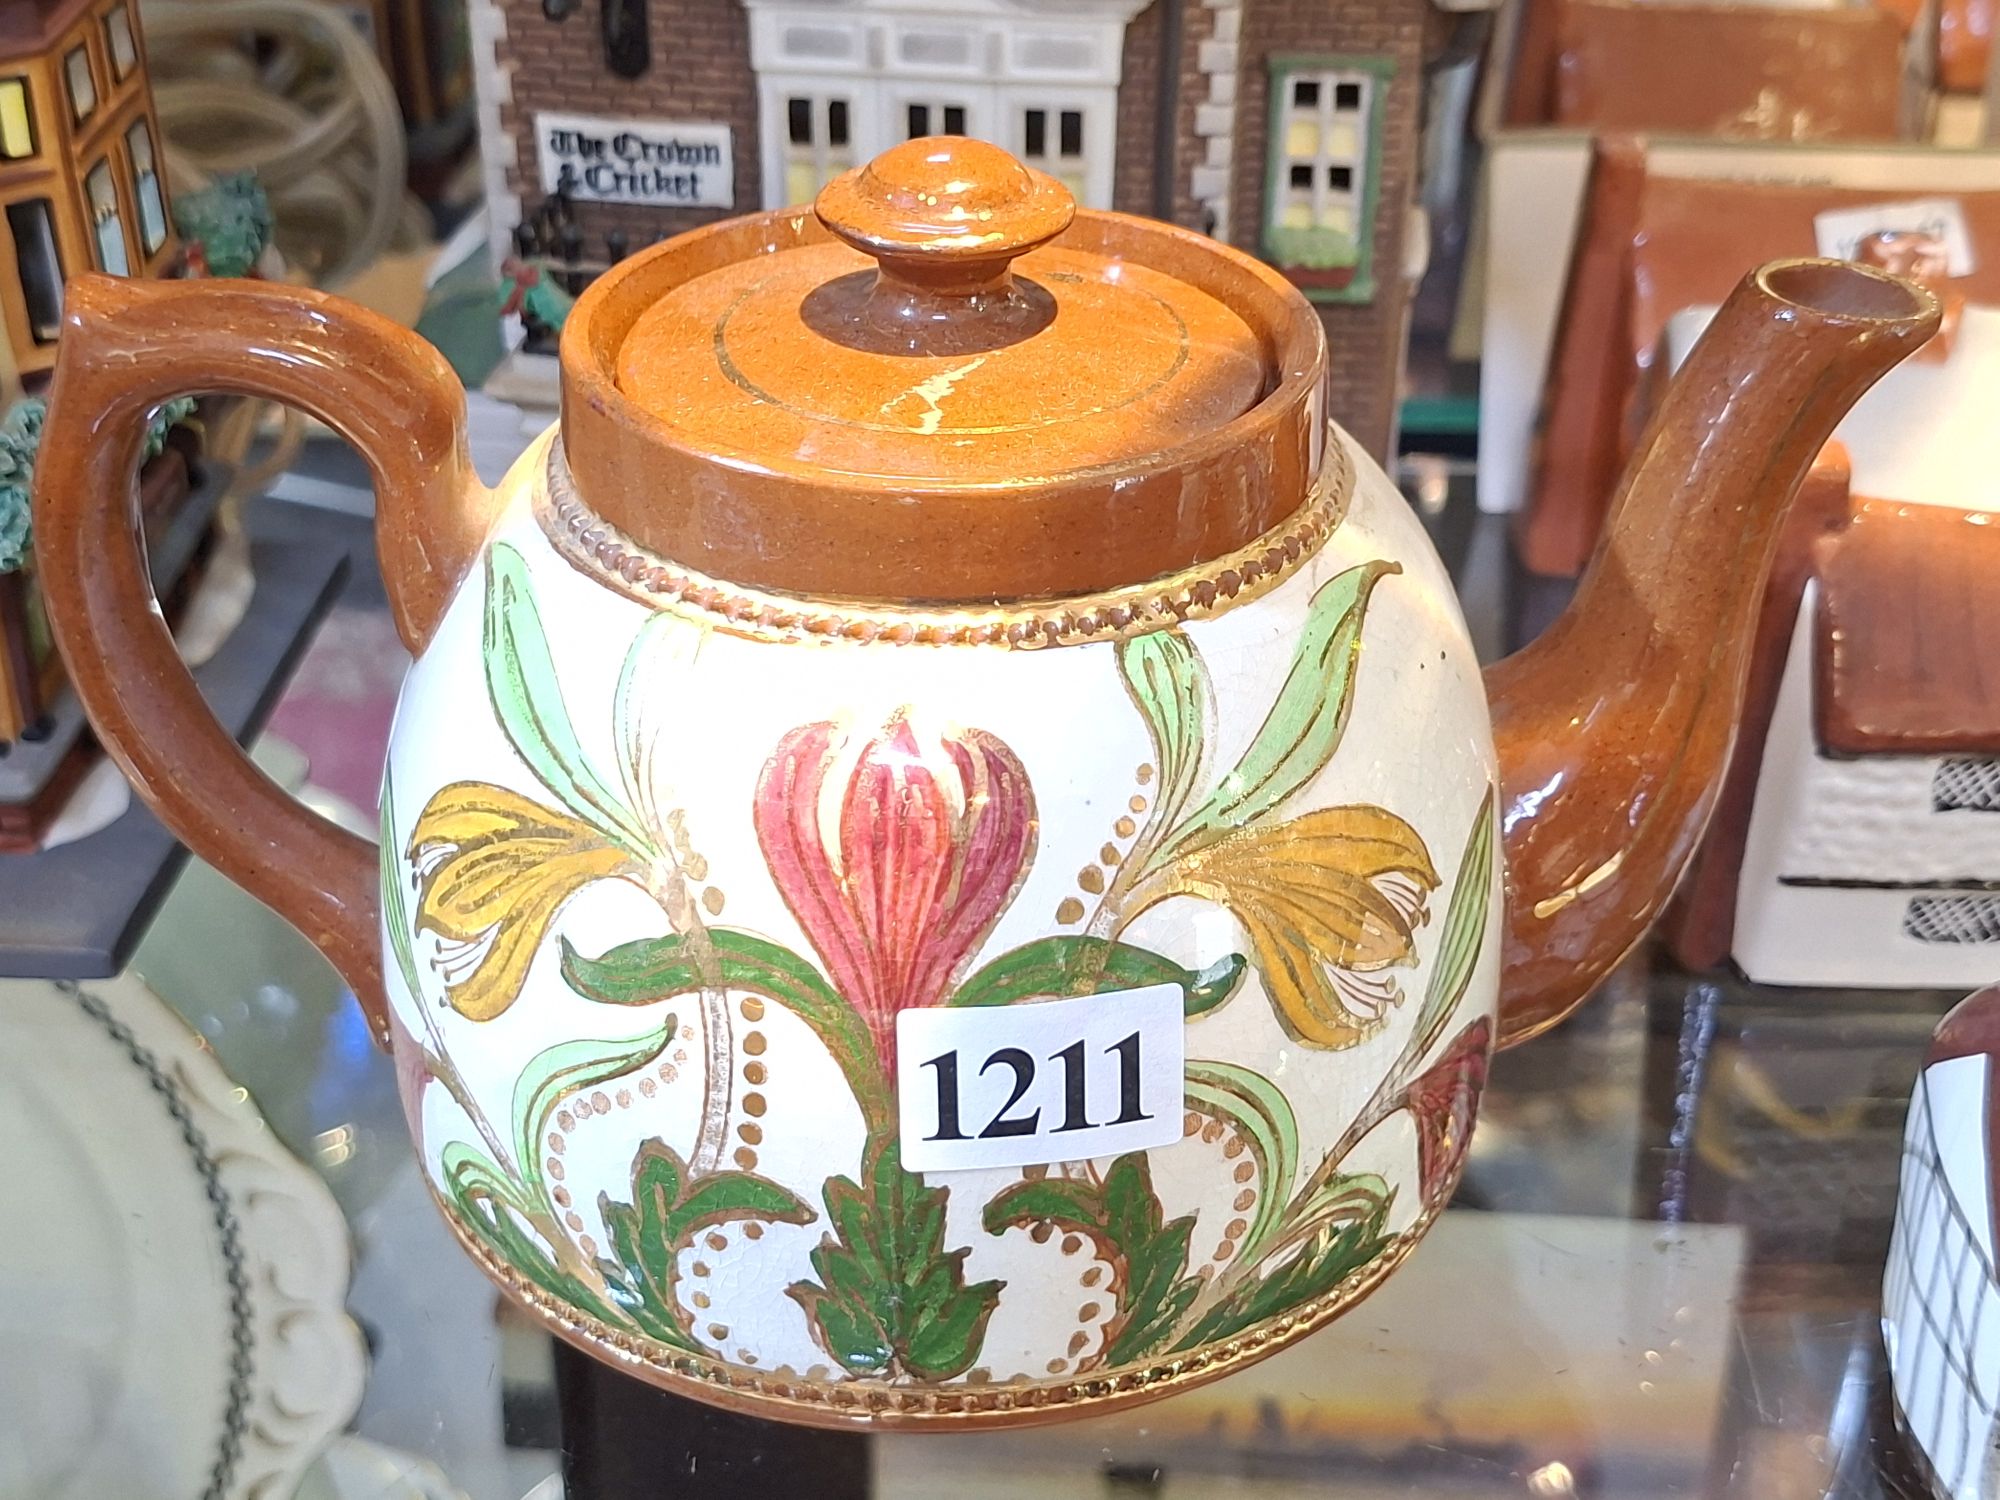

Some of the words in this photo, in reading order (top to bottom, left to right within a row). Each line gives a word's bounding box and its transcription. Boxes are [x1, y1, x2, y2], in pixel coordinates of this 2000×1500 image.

[550, 129, 606, 160] The
[612, 133, 721, 167] Crown
[585, 163, 701, 200] Cricket
[920, 1030, 1155, 1141] 1211
